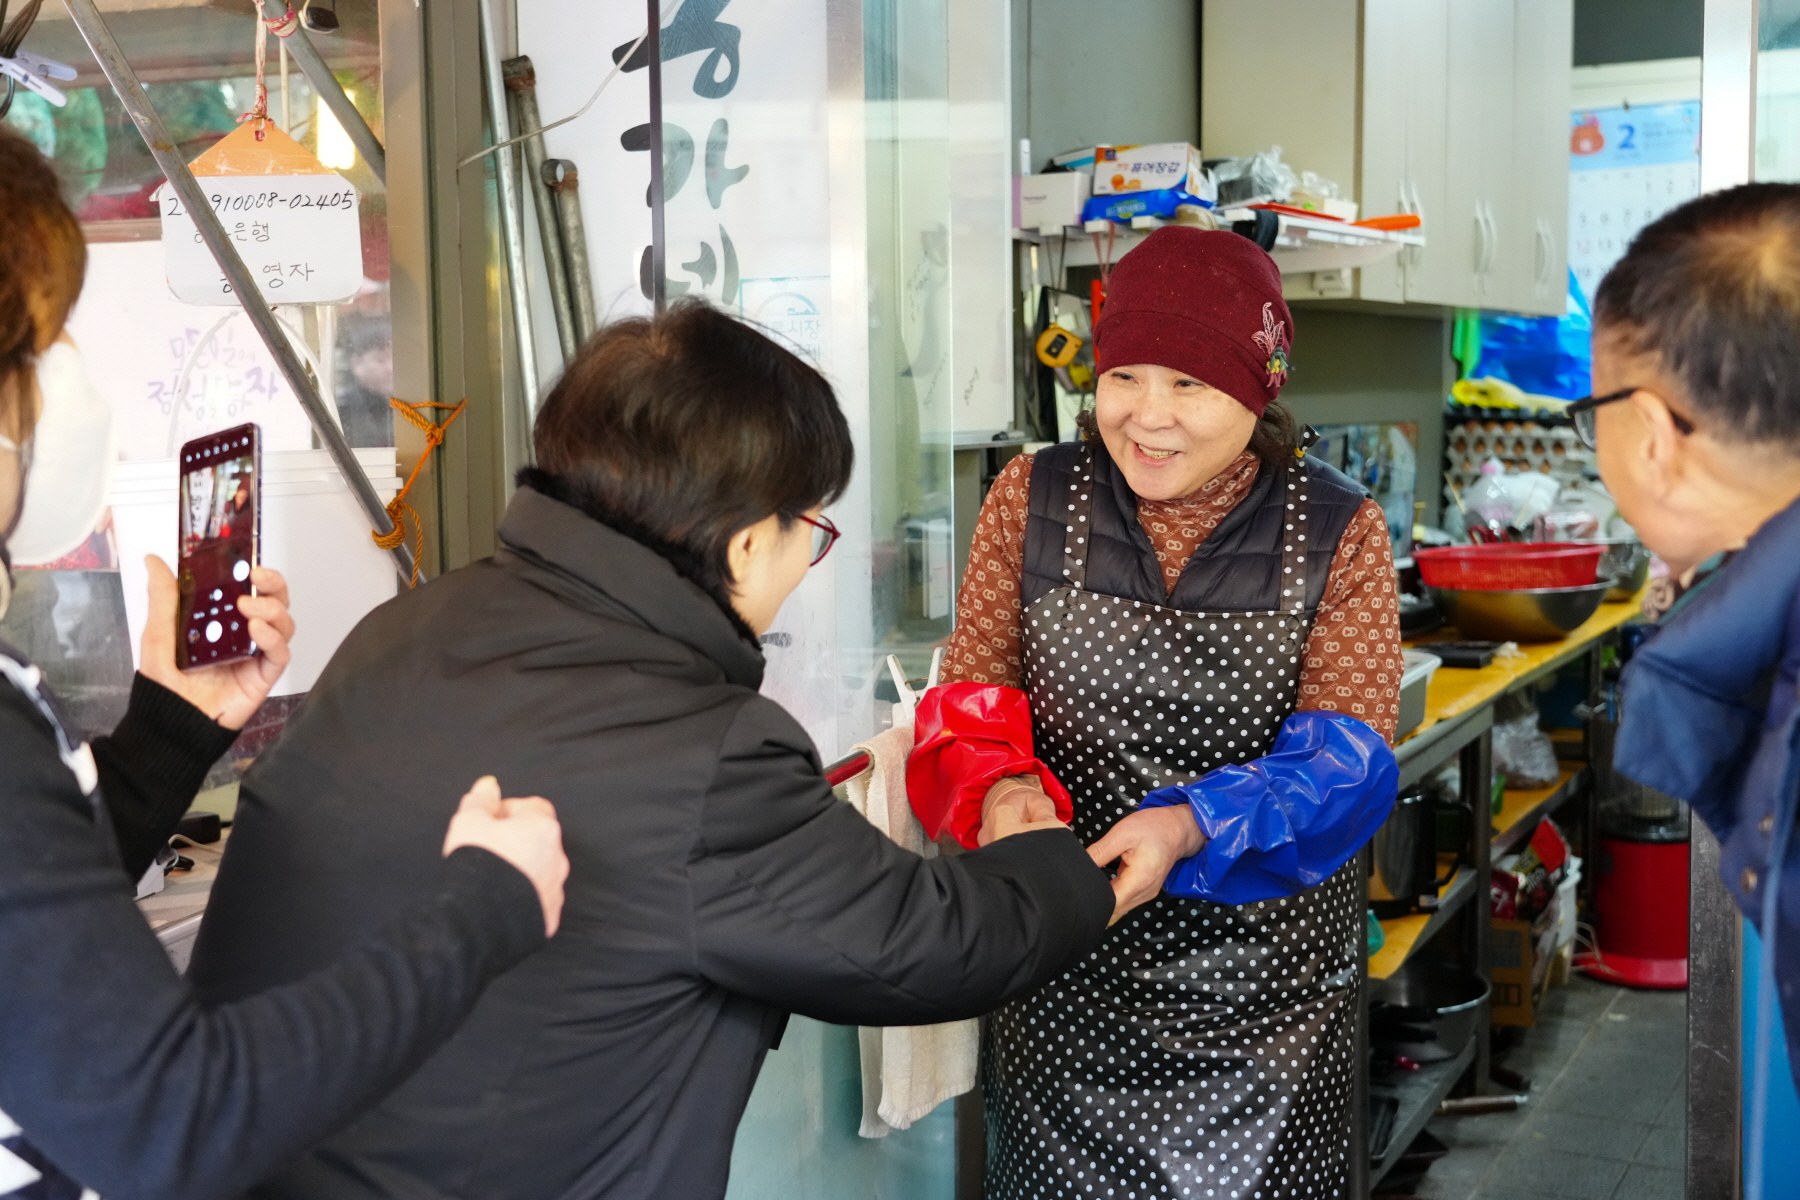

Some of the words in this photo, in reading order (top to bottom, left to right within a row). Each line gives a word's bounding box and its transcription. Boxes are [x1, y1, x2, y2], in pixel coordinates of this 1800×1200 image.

[1618, 124, 1635, 149] 2
[194, 221, 270, 243] 은행
[1321, 619, 1347, 643] Silkweed
[1320, 652, 1345, 674] Silkweed
